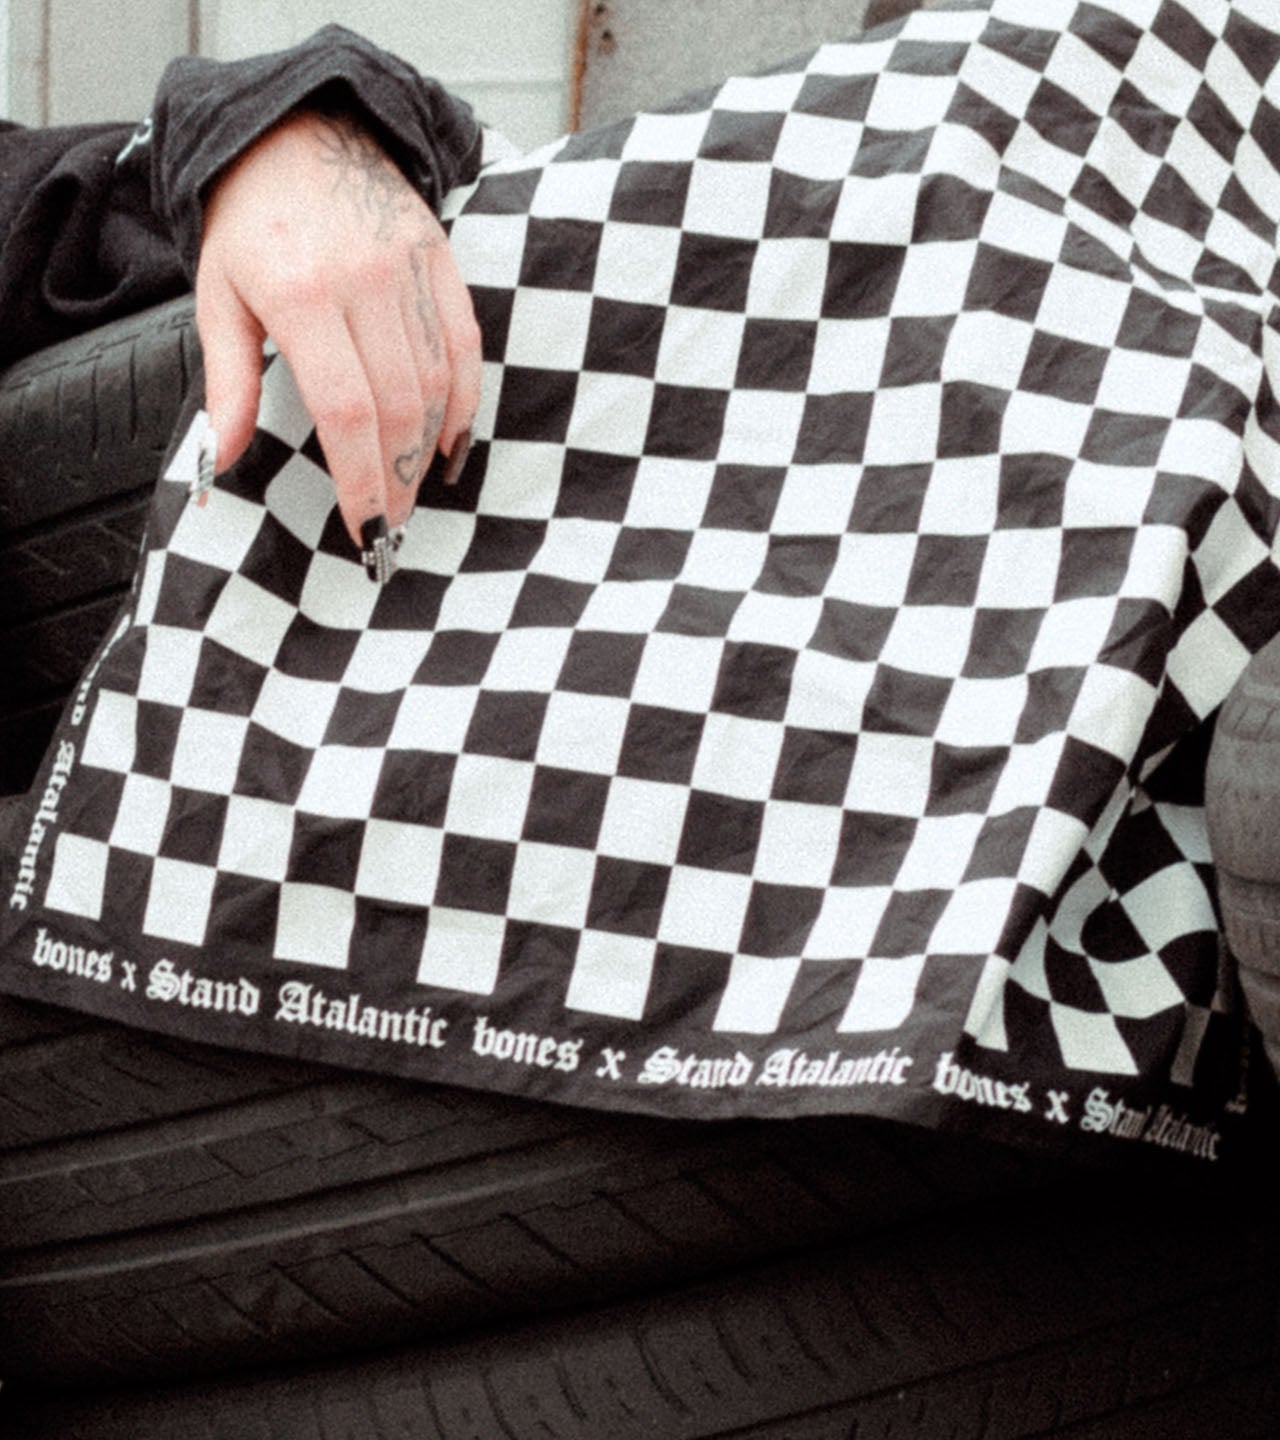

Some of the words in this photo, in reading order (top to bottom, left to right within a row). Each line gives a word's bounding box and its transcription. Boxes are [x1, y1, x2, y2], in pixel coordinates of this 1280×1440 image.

[32, 928, 115, 984] bones
[120, 960, 138, 993] x
[146, 958, 261, 1017] Stand
[274, 980, 449, 1050] Atalantic
[472, 1016, 584, 1073] bones
[595, 1046, 627, 1081] x
[637, 1045, 754, 1089] Stand
[755, 1046, 914, 1088] Atalantic
[931, 1051, 1032, 1113] bones
[1044, 1089, 1070, 1125] x
